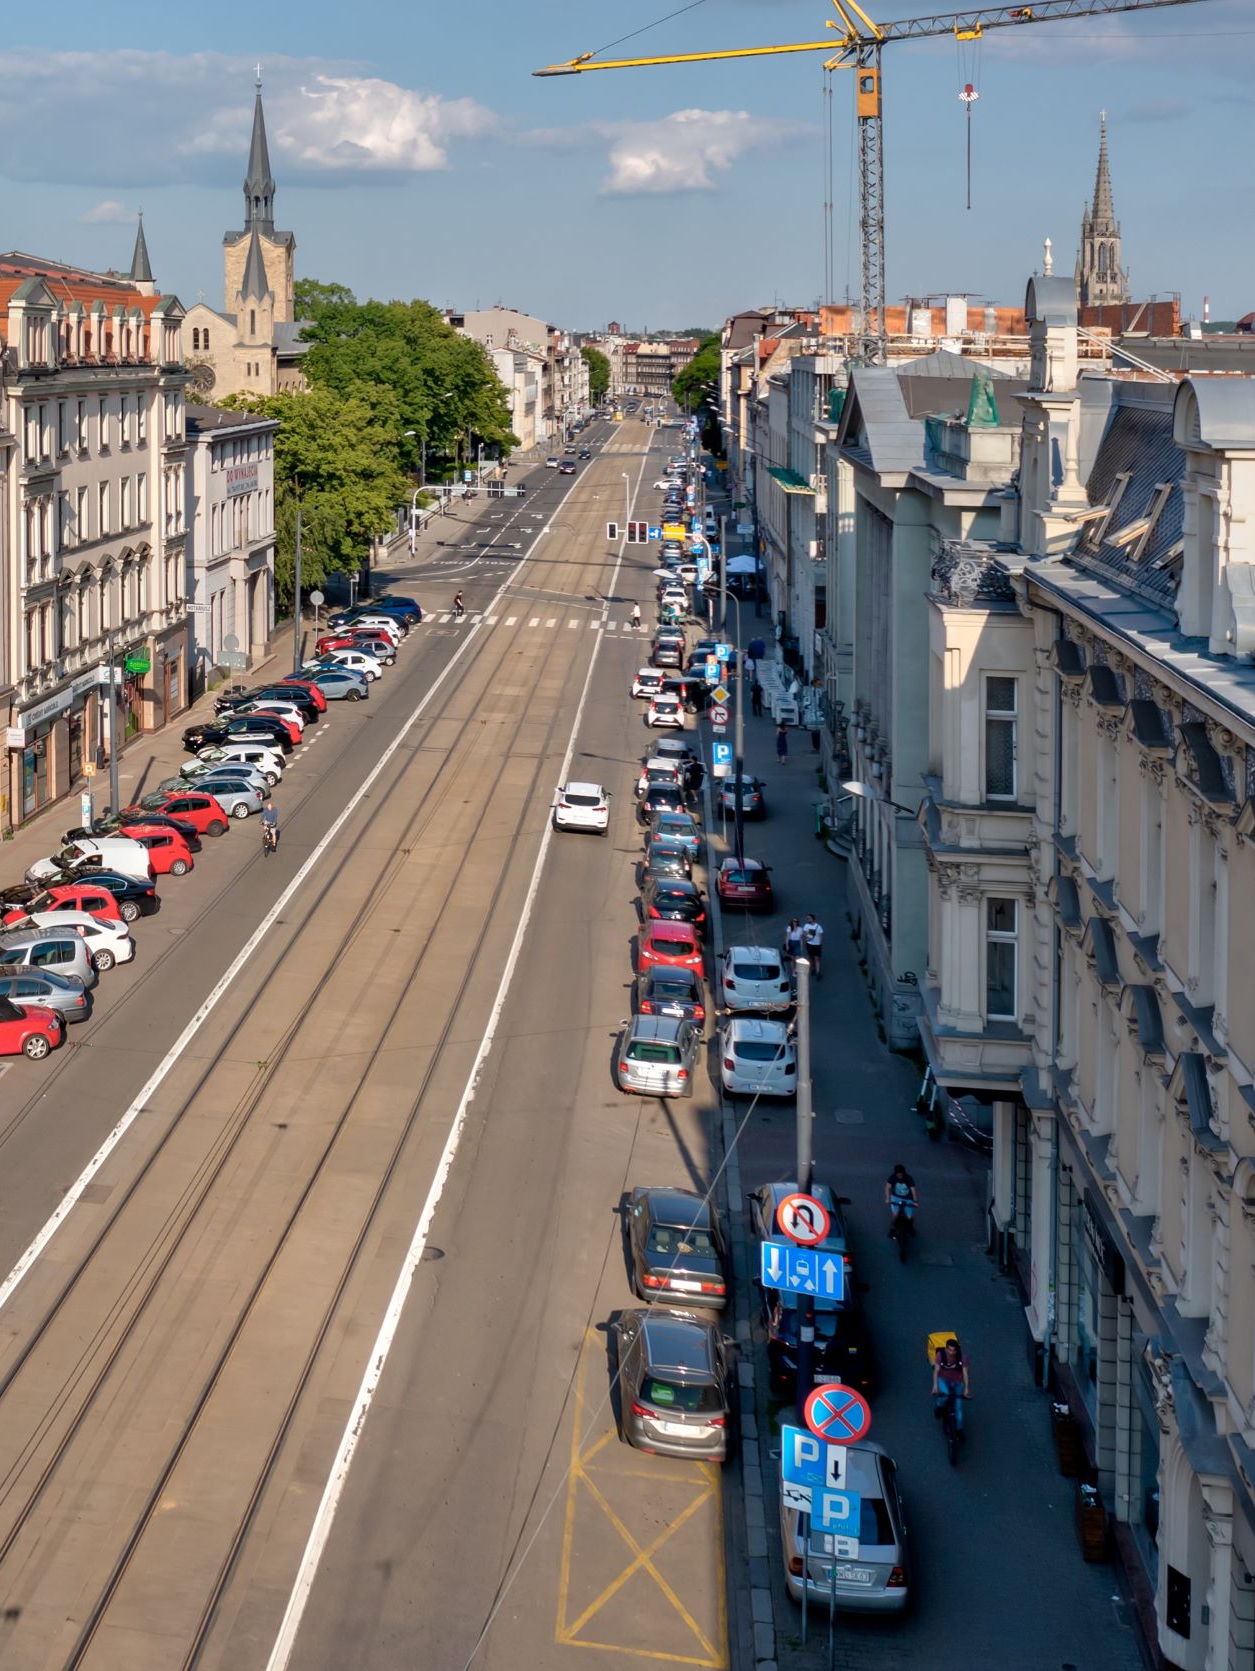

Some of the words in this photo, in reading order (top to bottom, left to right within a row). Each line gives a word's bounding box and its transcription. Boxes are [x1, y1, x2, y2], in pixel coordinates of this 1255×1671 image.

[718, 646, 725, 656] P
[708, 664, 716, 674] P
[718, 745, 728, 759] P
[794, 1434, 820, 1468] P
[822, 1493, 850, 1527] P
